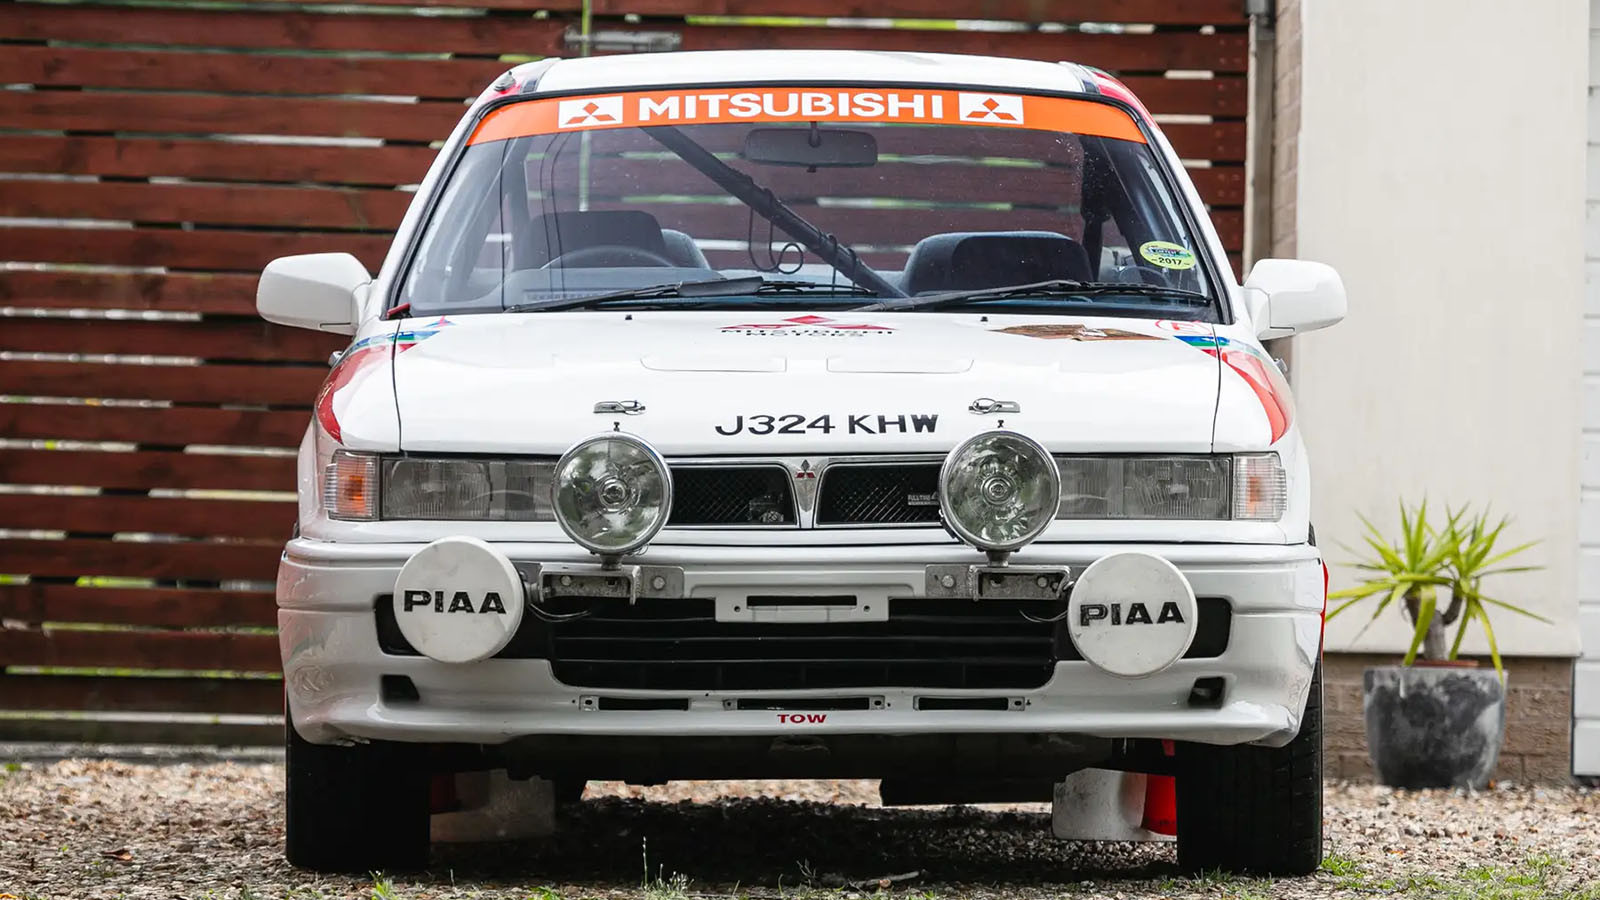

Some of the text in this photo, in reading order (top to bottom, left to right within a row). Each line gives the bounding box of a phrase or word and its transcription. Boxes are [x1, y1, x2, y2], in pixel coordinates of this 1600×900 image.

[639, 93, 943, 121] MITSUBISHI
[1158, 257, 1182, 266] 2017
[715, 414, 939, 436] J324 KHW
[404, 590, 507, 615] PIAA
[1080, 602, 1185, 626] PIAA
[777, 714, 827, 724] TOW
